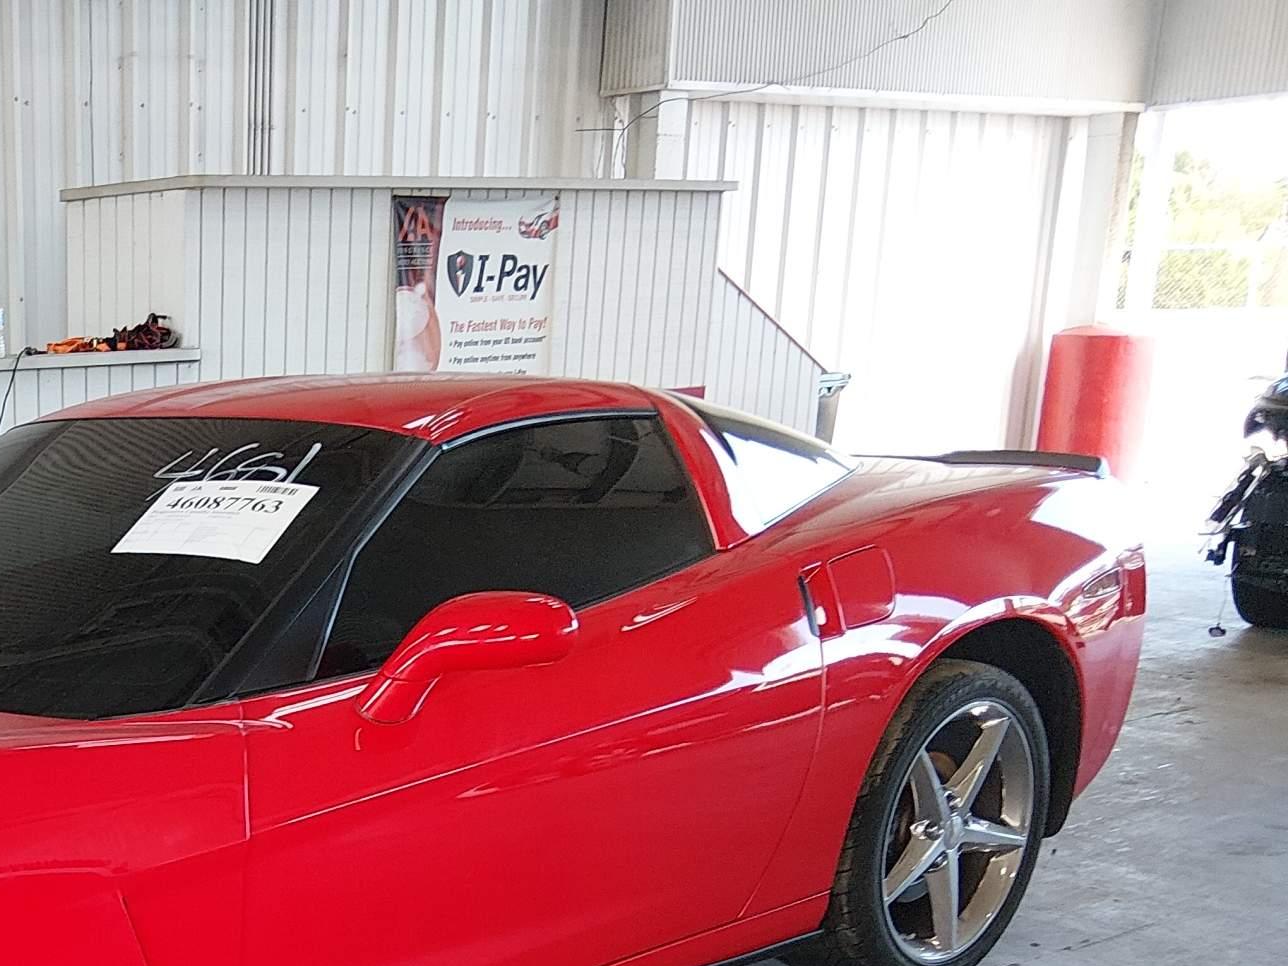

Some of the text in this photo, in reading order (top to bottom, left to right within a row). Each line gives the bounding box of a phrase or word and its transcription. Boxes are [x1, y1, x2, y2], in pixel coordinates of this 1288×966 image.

[452, 217, 512, 233] Introducing...
[473, 254, 550, 301] I-Pay
[450, 317, 547, 333] The Fastest Way to Pay!
[166, 495, 284, 514] 46087763
